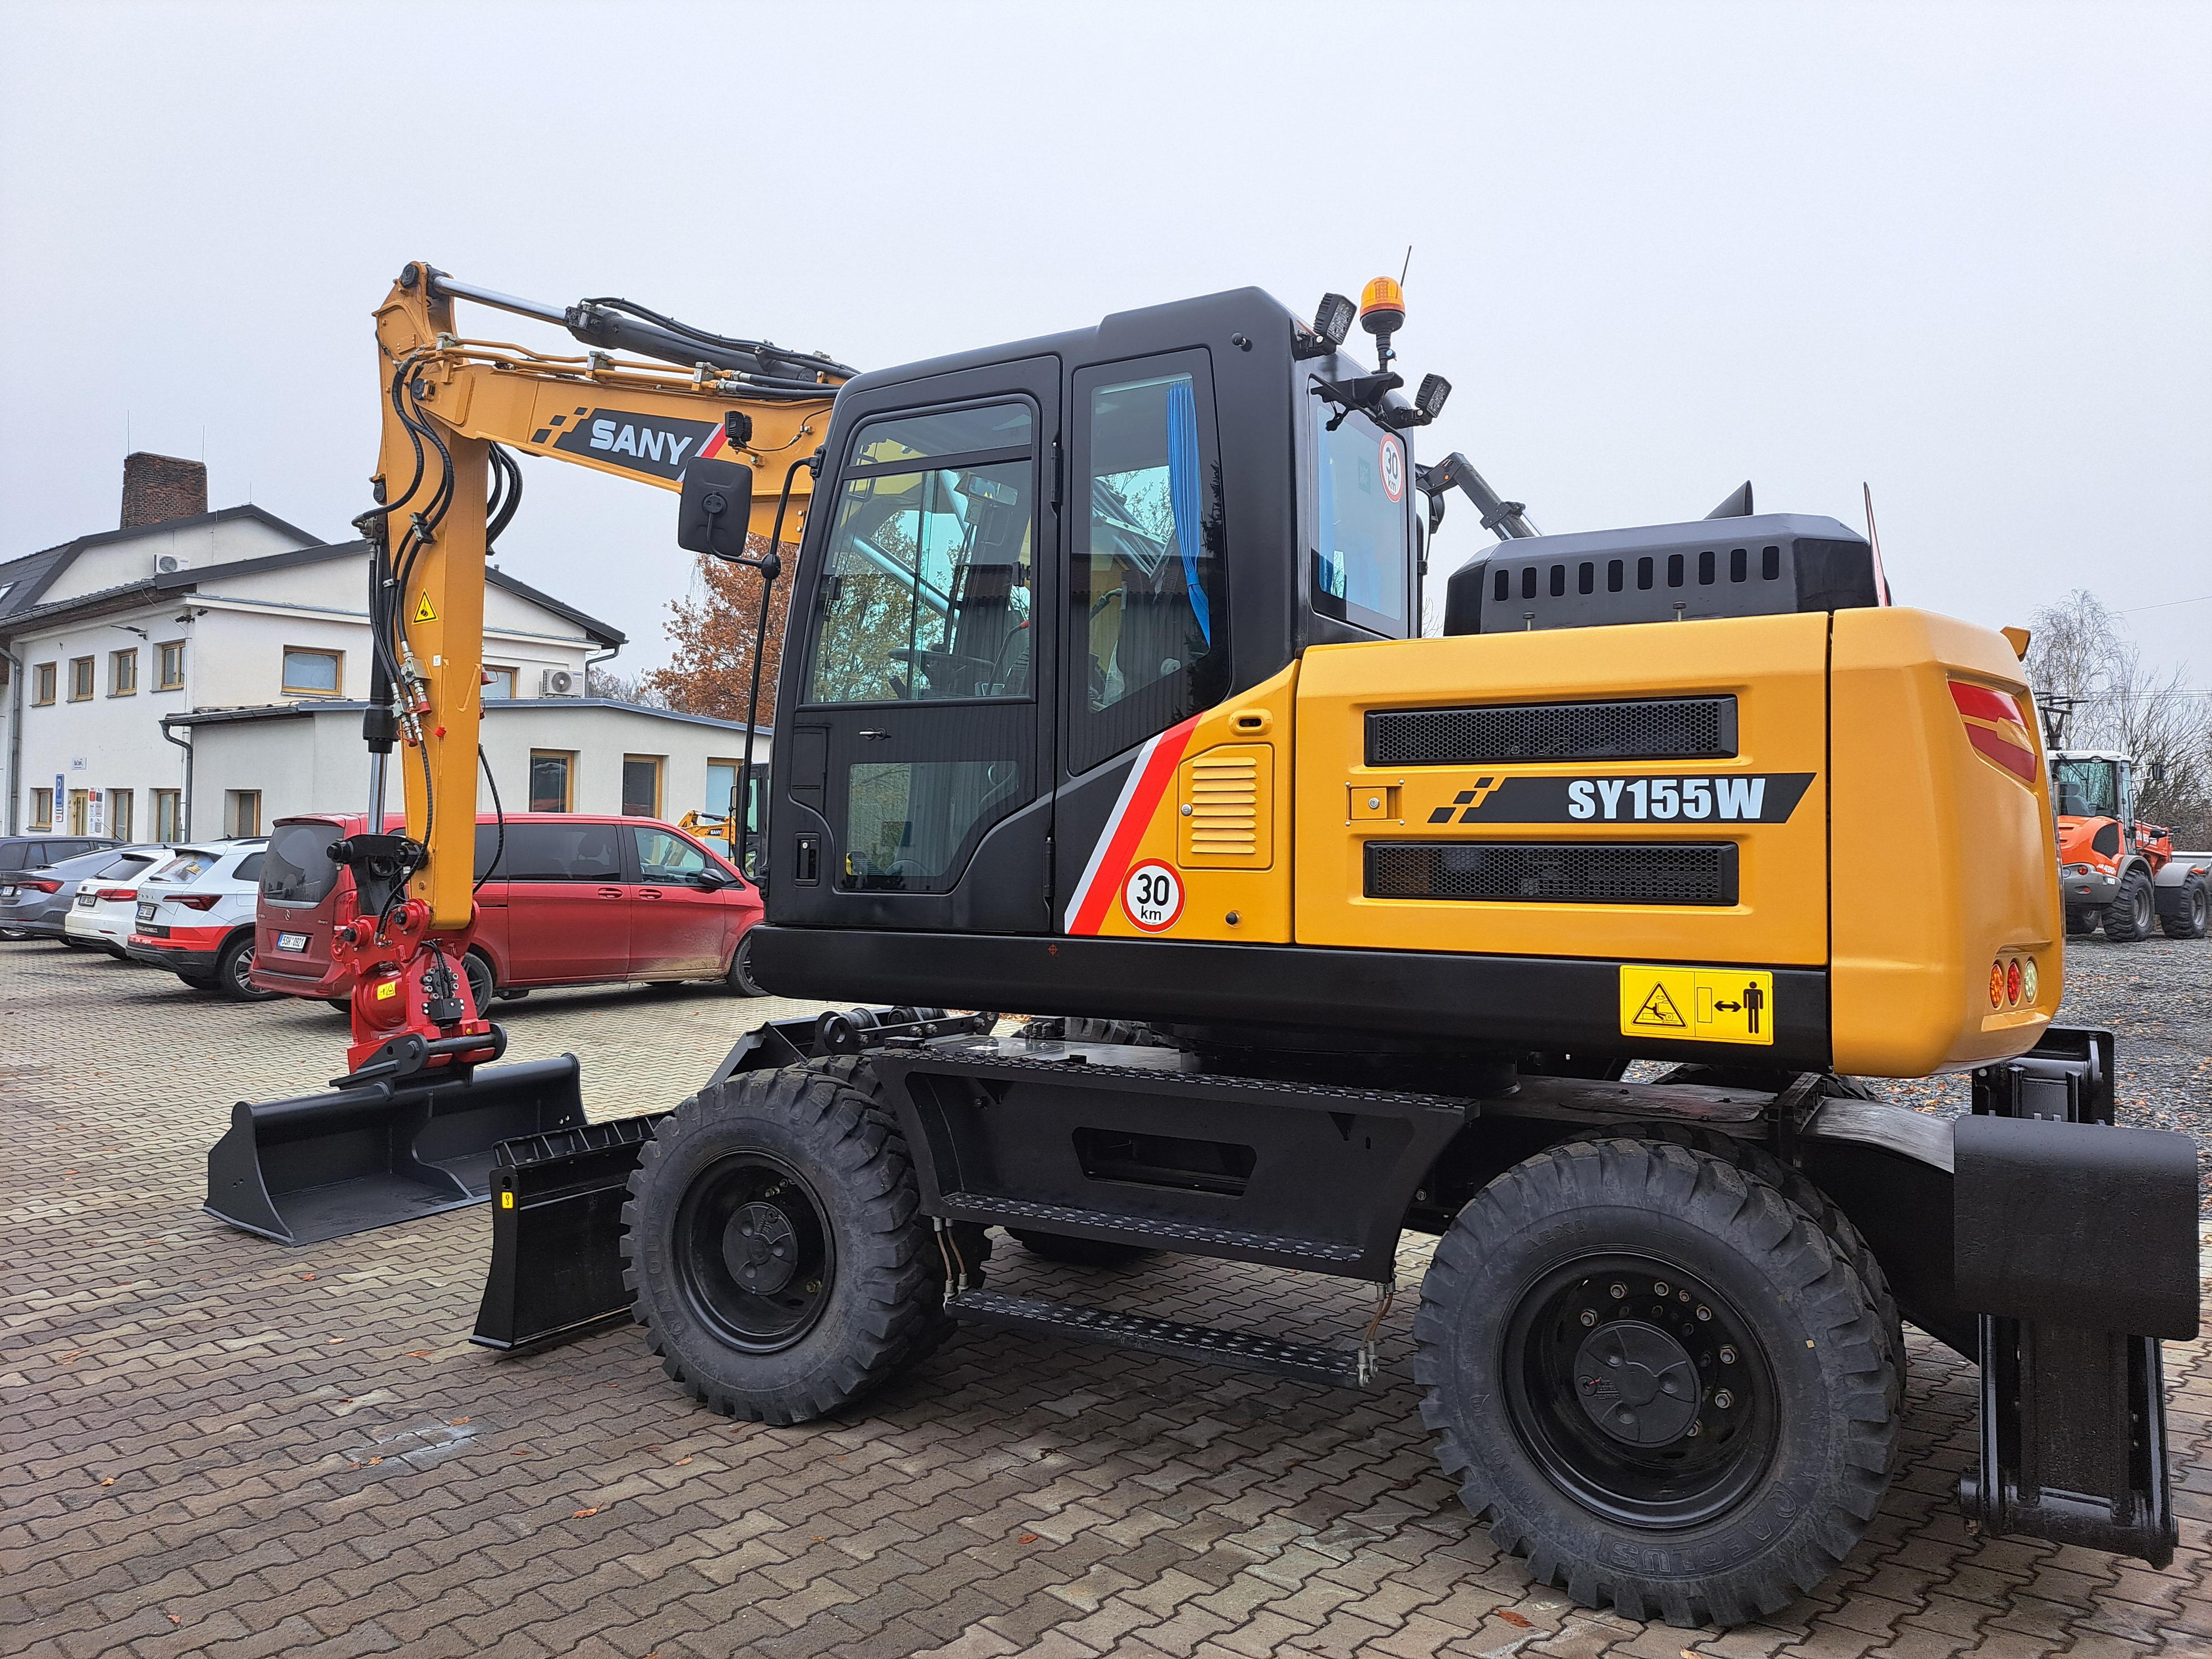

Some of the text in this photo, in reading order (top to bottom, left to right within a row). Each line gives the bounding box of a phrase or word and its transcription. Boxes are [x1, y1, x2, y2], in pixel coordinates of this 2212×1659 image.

[589, 419, 692, 465] SANY
[1386, 447, 1398, 479] 30
[1388, 476, 1396, 492] km
[57, 778, 62, 796] P
[1568, 778, 1766, 820] SY155W
[1136, 874, 1170, 906] 30
[1141, 905, 1161, 921] km
[281, 936, 304, 947] 5SH 0921
[1610, 1511, 1772, 1573] AEOLUS
